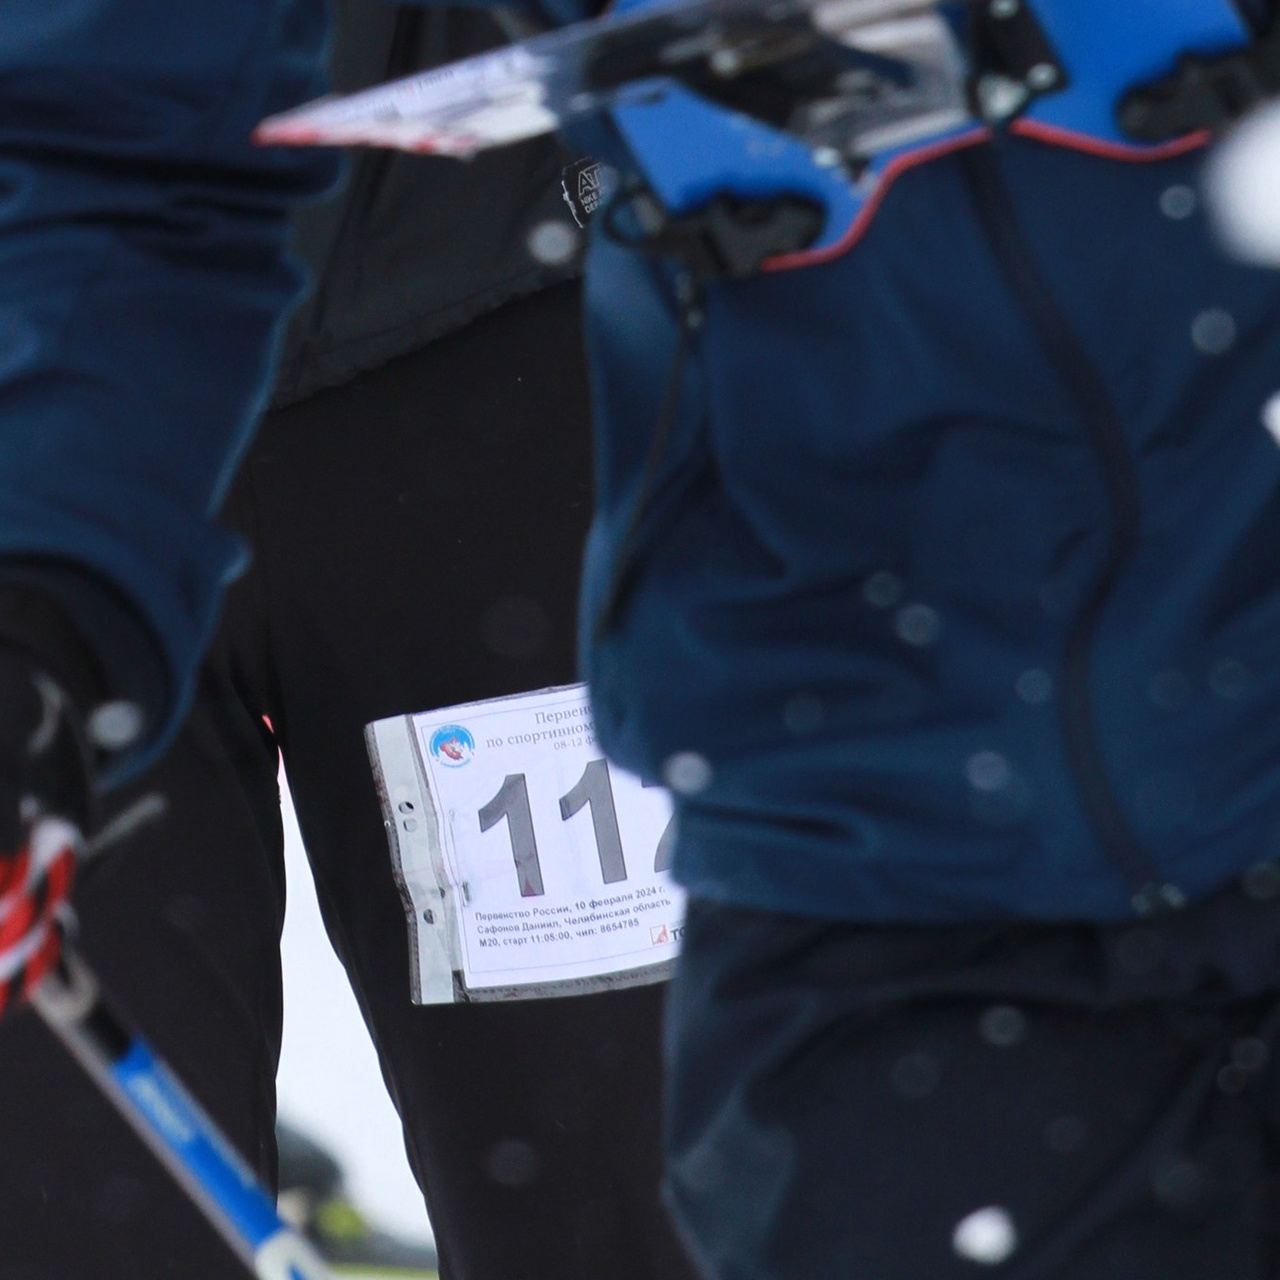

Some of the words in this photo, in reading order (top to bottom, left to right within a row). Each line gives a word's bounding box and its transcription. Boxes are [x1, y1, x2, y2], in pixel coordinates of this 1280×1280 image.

[486, 738, 503, 749] по
[553, 738, 583, 751] 08-12
[475, 910, 531, 923] Первенство
[533, 905, 572, 917] России,
[575, 901, 586, 911] 10
[588, 893, 633, 909] февраля
[635, 886, 657, 899] 2024
[477, 924, 520, 935] Сафонов
[522, 920, 562, 932] Даниил,
[564, 907, 631, 926] Челябинская
[633, 898, 671, 913] область
[479, 937, 501, 947] М20,
[502, 936, 528, 947] старт
[531, 931, 573, 943] 11:05:00,
[575, 928, 597, 938] чип:
[600, 918, 640, 933] 8654785
